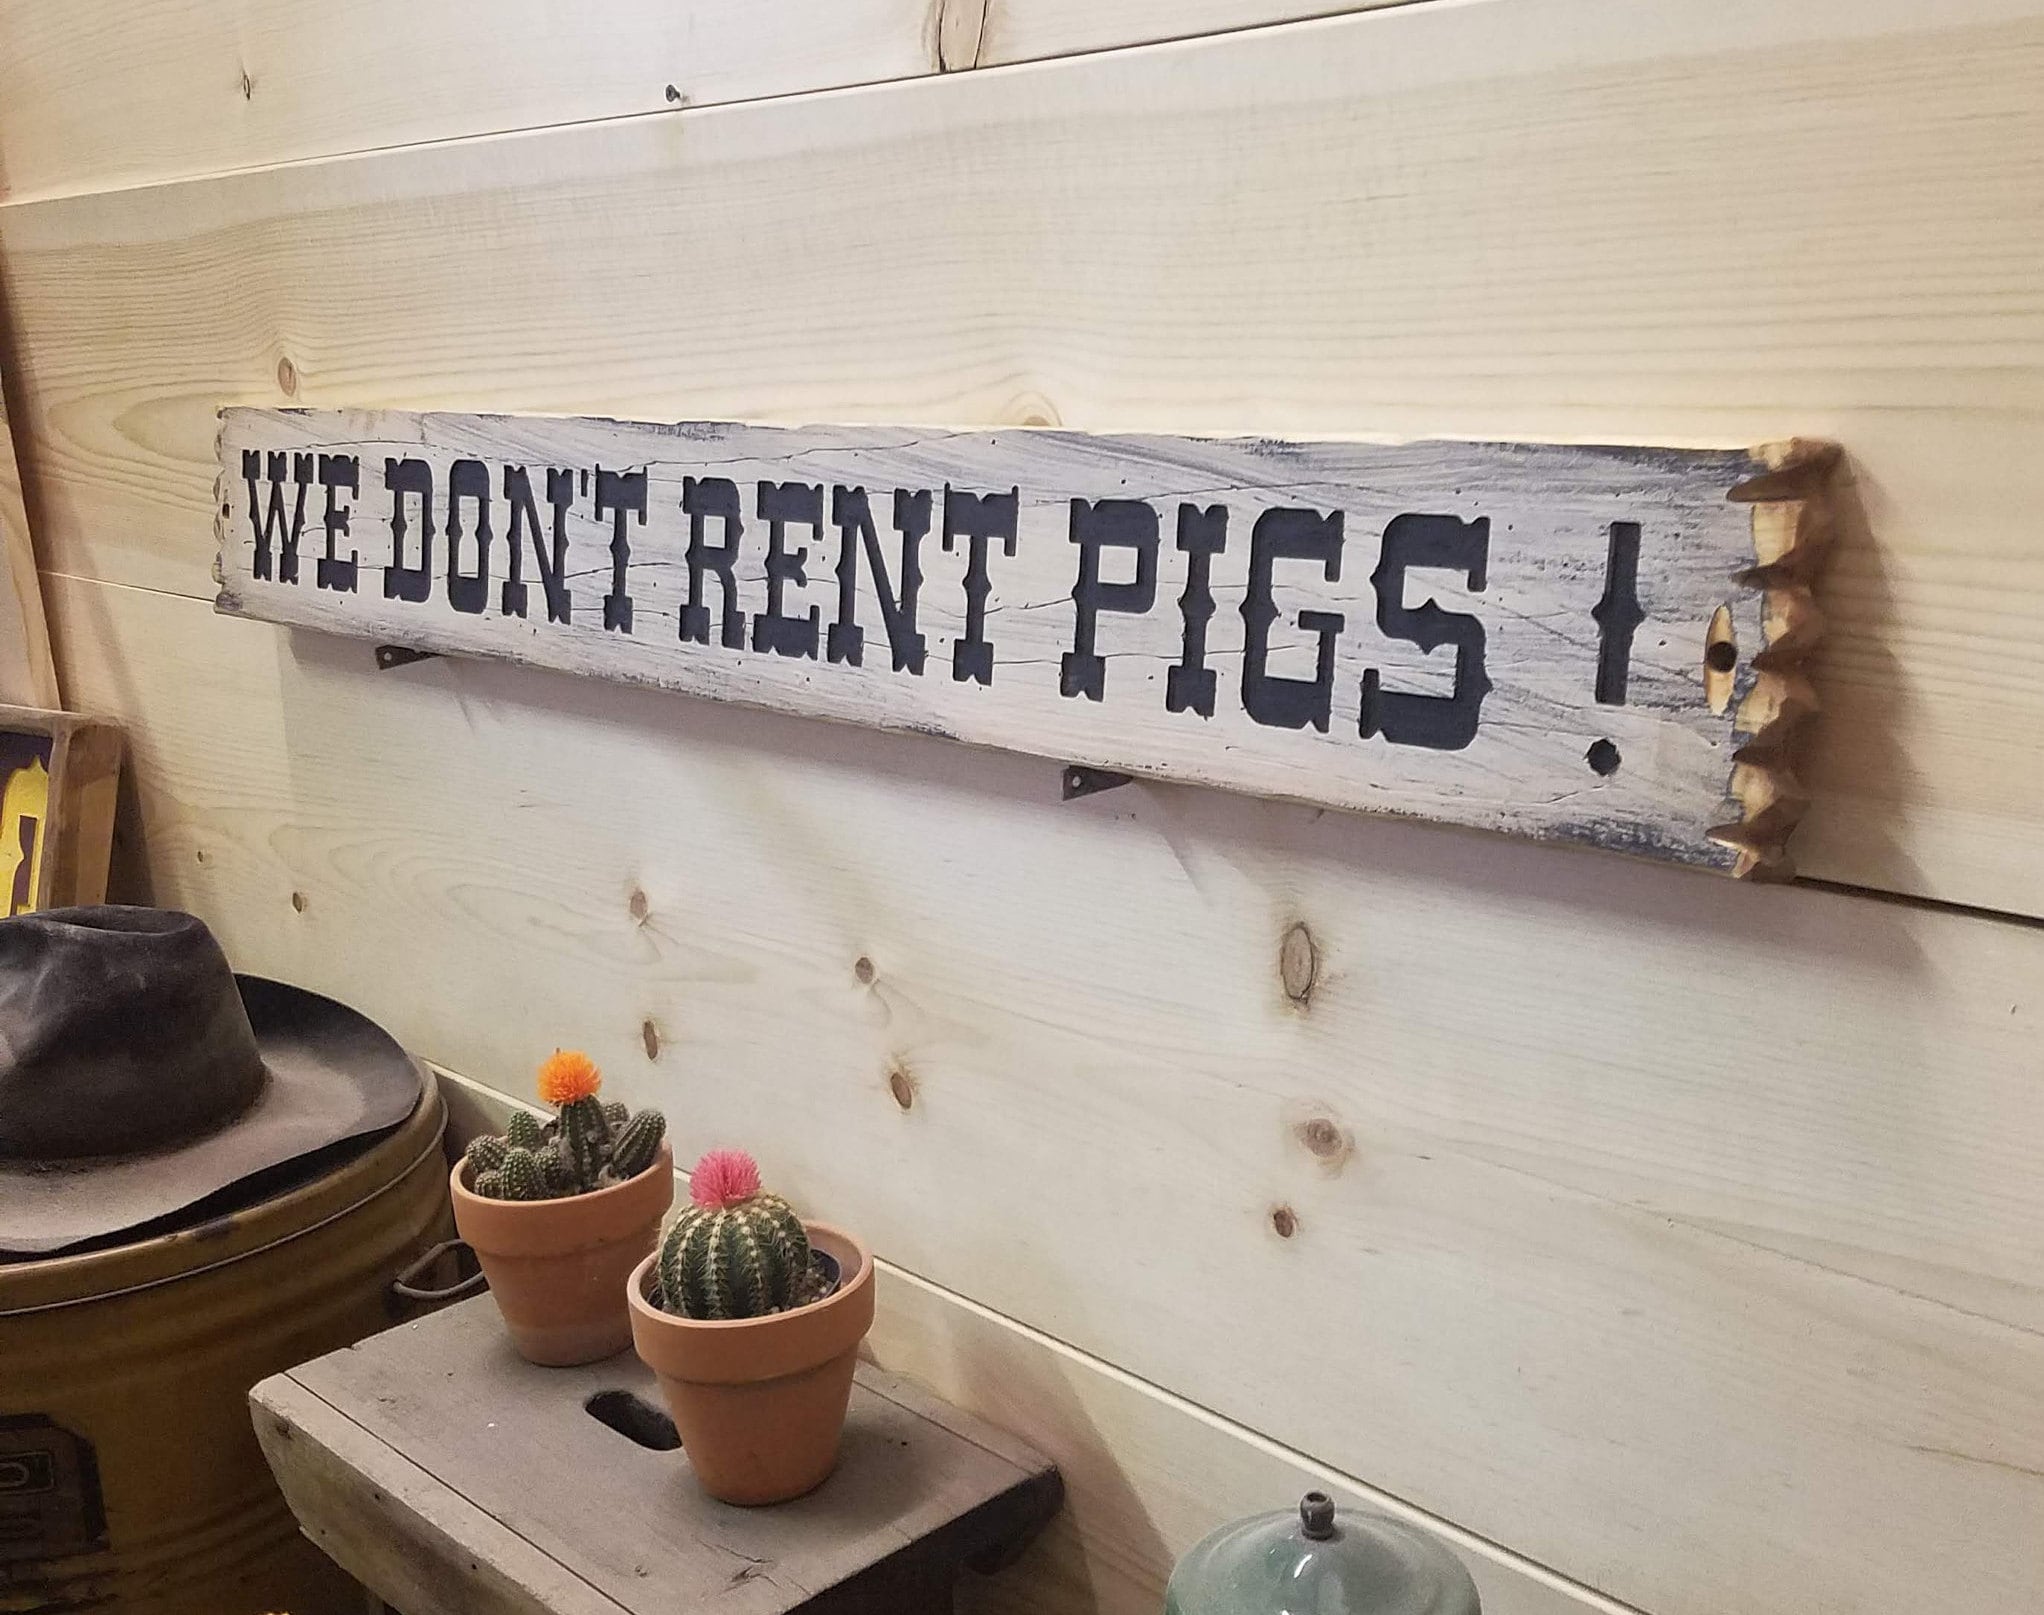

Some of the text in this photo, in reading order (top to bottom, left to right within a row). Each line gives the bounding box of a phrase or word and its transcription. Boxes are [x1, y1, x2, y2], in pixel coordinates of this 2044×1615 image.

[242, 449, 359, 593] WE
[384, 458, 648, 634] DON'T
[679, 475, 1019, 687] RENT
